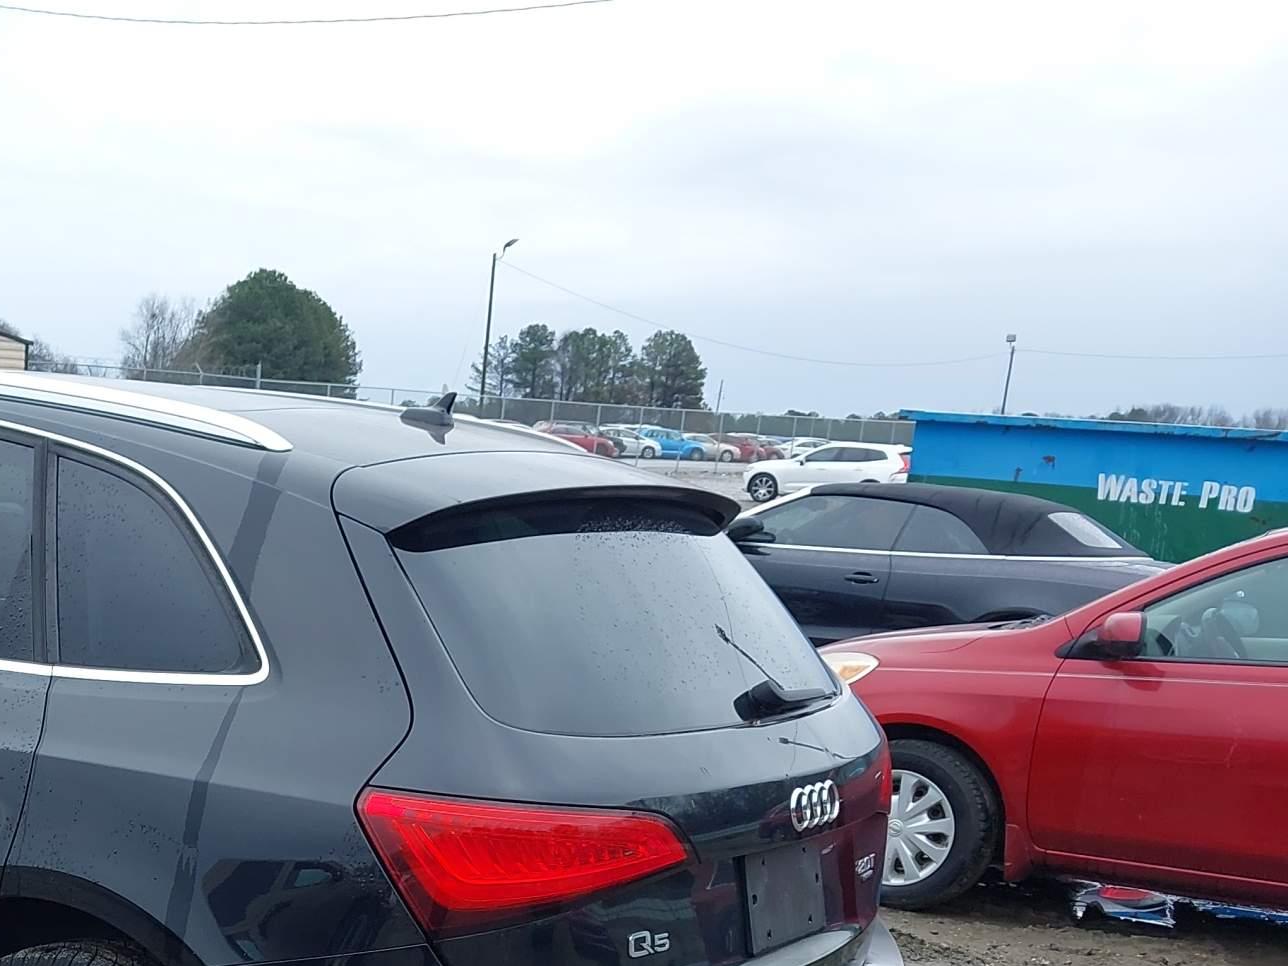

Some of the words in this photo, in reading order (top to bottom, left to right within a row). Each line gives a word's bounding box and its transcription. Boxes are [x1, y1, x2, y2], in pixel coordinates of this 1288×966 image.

[1096, 472, 1190, 507] WASTE
[1198, 480, 1257, 514] PRO
[628, 930, 670, 958] Q5
